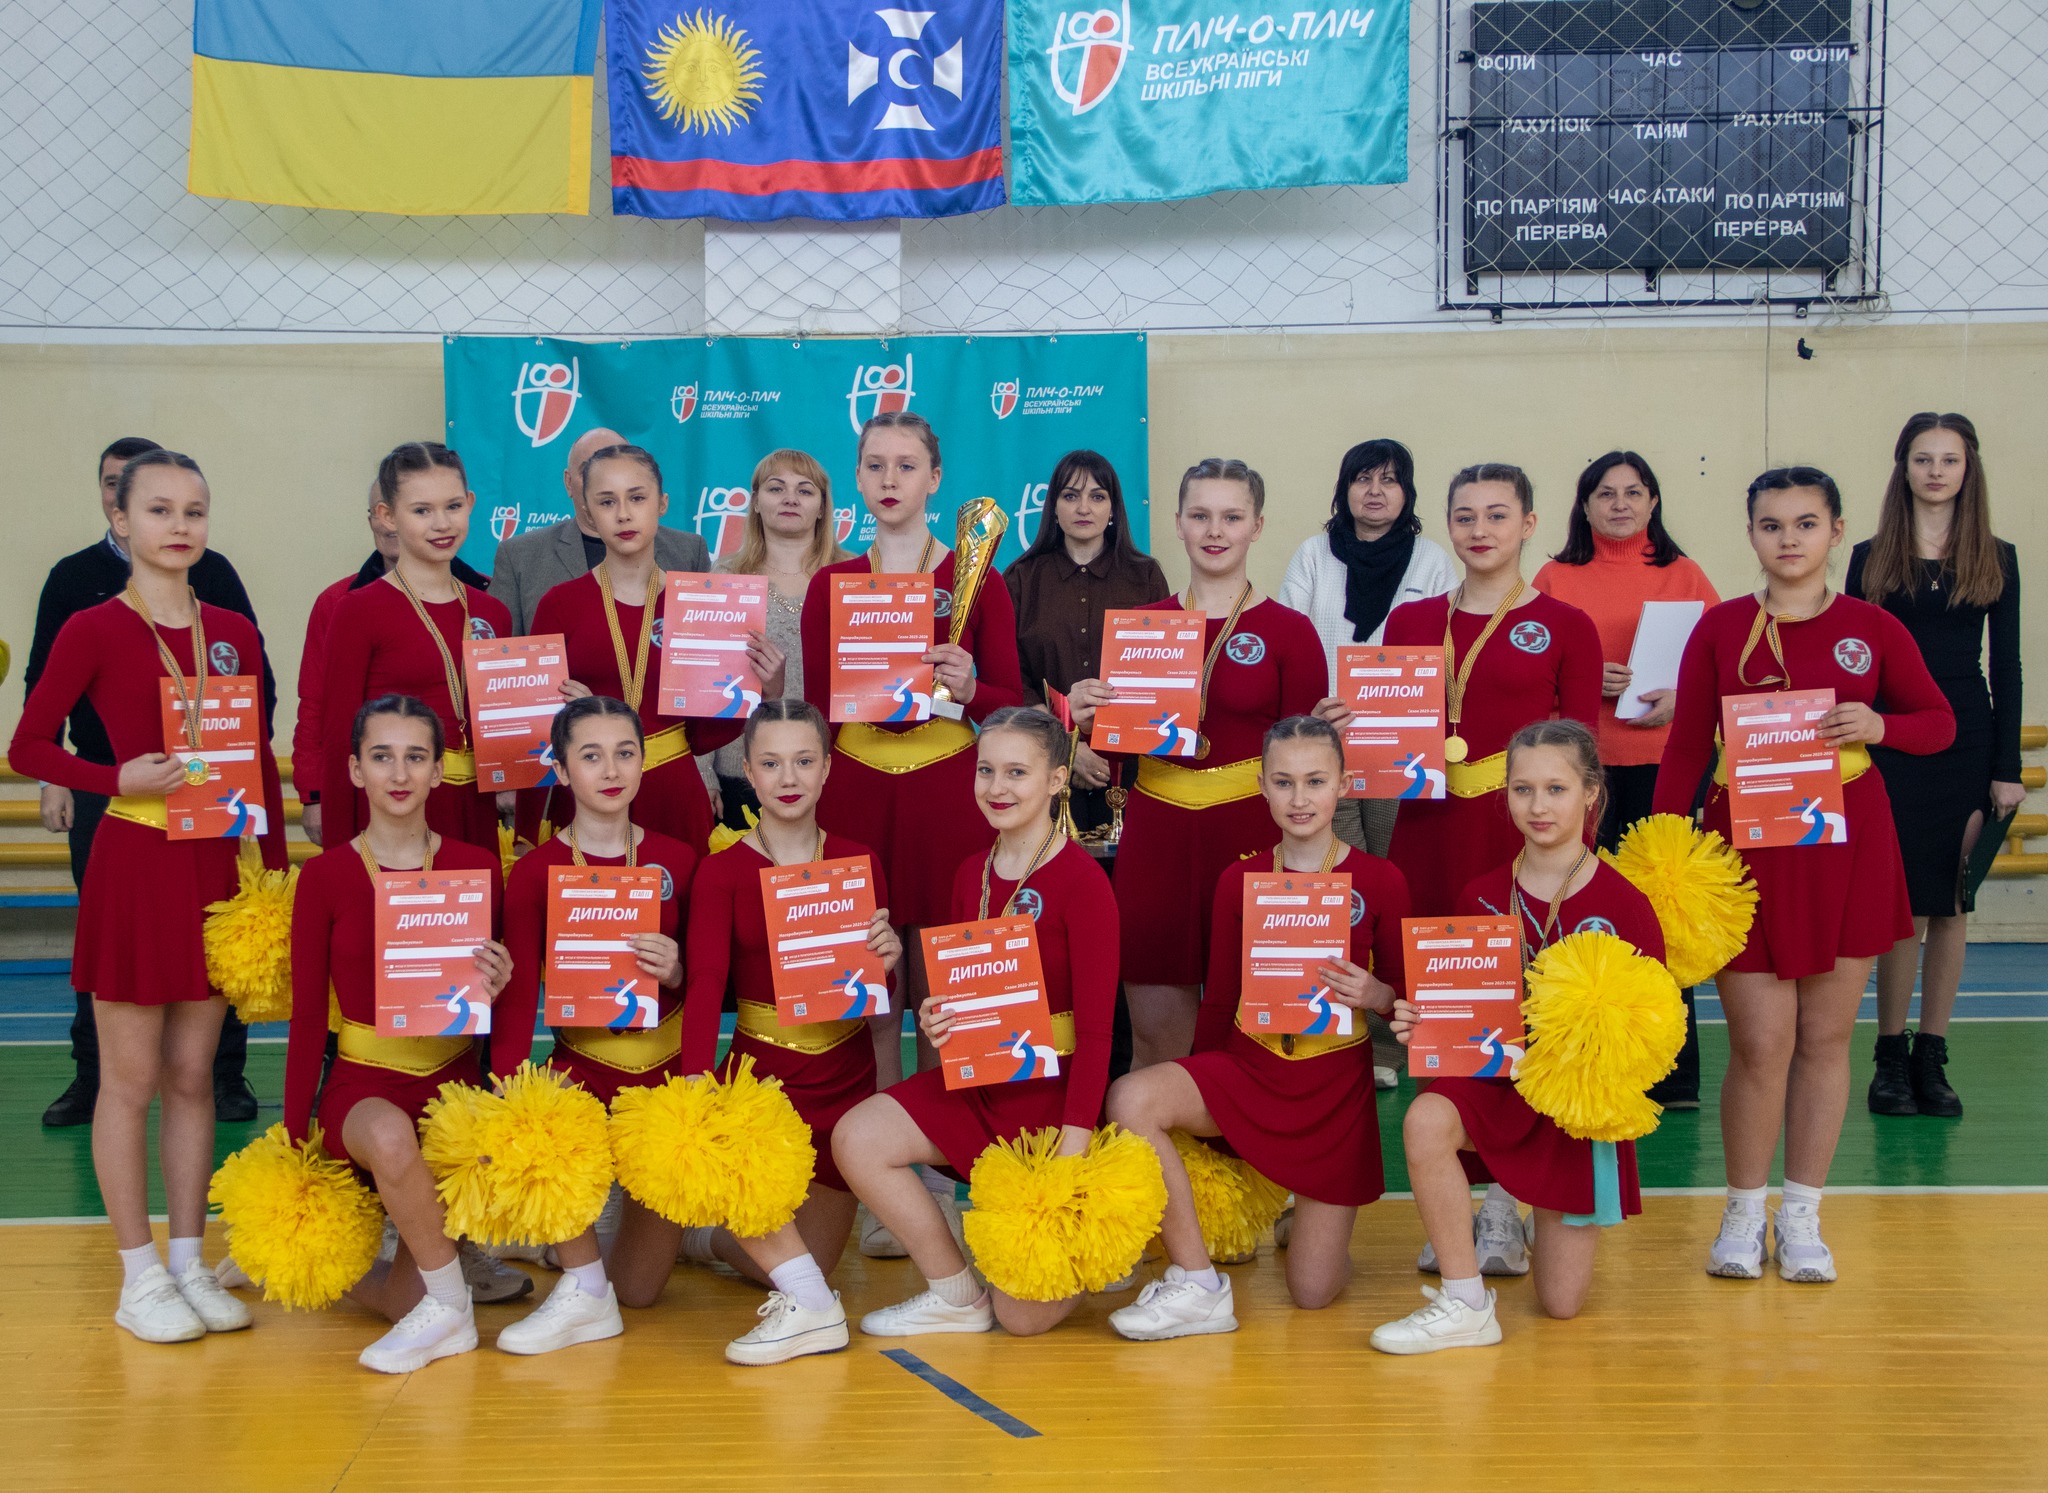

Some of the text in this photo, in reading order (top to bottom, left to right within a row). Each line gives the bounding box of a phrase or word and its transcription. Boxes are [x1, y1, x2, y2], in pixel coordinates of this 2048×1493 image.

[1152, 8, 1374, 55] ПЛІЧ-О-ПЛІЧ
[1477, 54, 1536, 72] ФОЛИ
[1641, 52, 1682, 67] ЧАС
[1790, 48, 1849, 63] ФОЛИ
[1145, 49, 1310, 81] ВСЕУКРАЇНСЬКІ
[1140, 70, 1282, 102] ШКІЛЬНІ ЛІГИ
[1609, 187, 1715, 205] ЧАС АТАКИ
[1725, 192, 1845, 210] ПО ПАРТІЯМ
[1476, 200, 1504, 216] ПО
[1516, 222, 1608, 241] ПЕРЕРВА
[1714, 219, 1807, 237] ПЕРЕРВА
[704, 390, 781, 402] ПЛІЧ-О-ПЛІЧ
[1026, 385, 1104, 398] ПЛІЧ-О-ПЛІЧ
[702, 403, 758, 411] ВСЕУКРАЇНСЬКІ
[1024, 399, 1081, 408] ВСЕУКРАЇНСЬКІ
[683, 609, 746, 623] ДИПЛОМ
[849, 612, 913, 626] ДИПЛОМ
[1120, 647, 1184, 661] ДИПЛОМ
[486, 674, 549, 693] ДИПЛОМ
[1357, 686, 1424, 700] ДИПЛОМ
[180, 718, 240, 734] ДПЛОМ
[1746, 729, 1815, 749] ДИПЛОМ
[568, 907, 638, 922] ДИПЛОМ
[786, 898, 854, 922] ДИПЛОМ
[396, 912, 468, 930] ДИПЛОМ
[1263, 914, 1330, 929] ДИПЛОМ
[949, 958, 1018, 984] ДИПЛОМ
[1426, 957, 1498, 973] ДИПЛОМ
